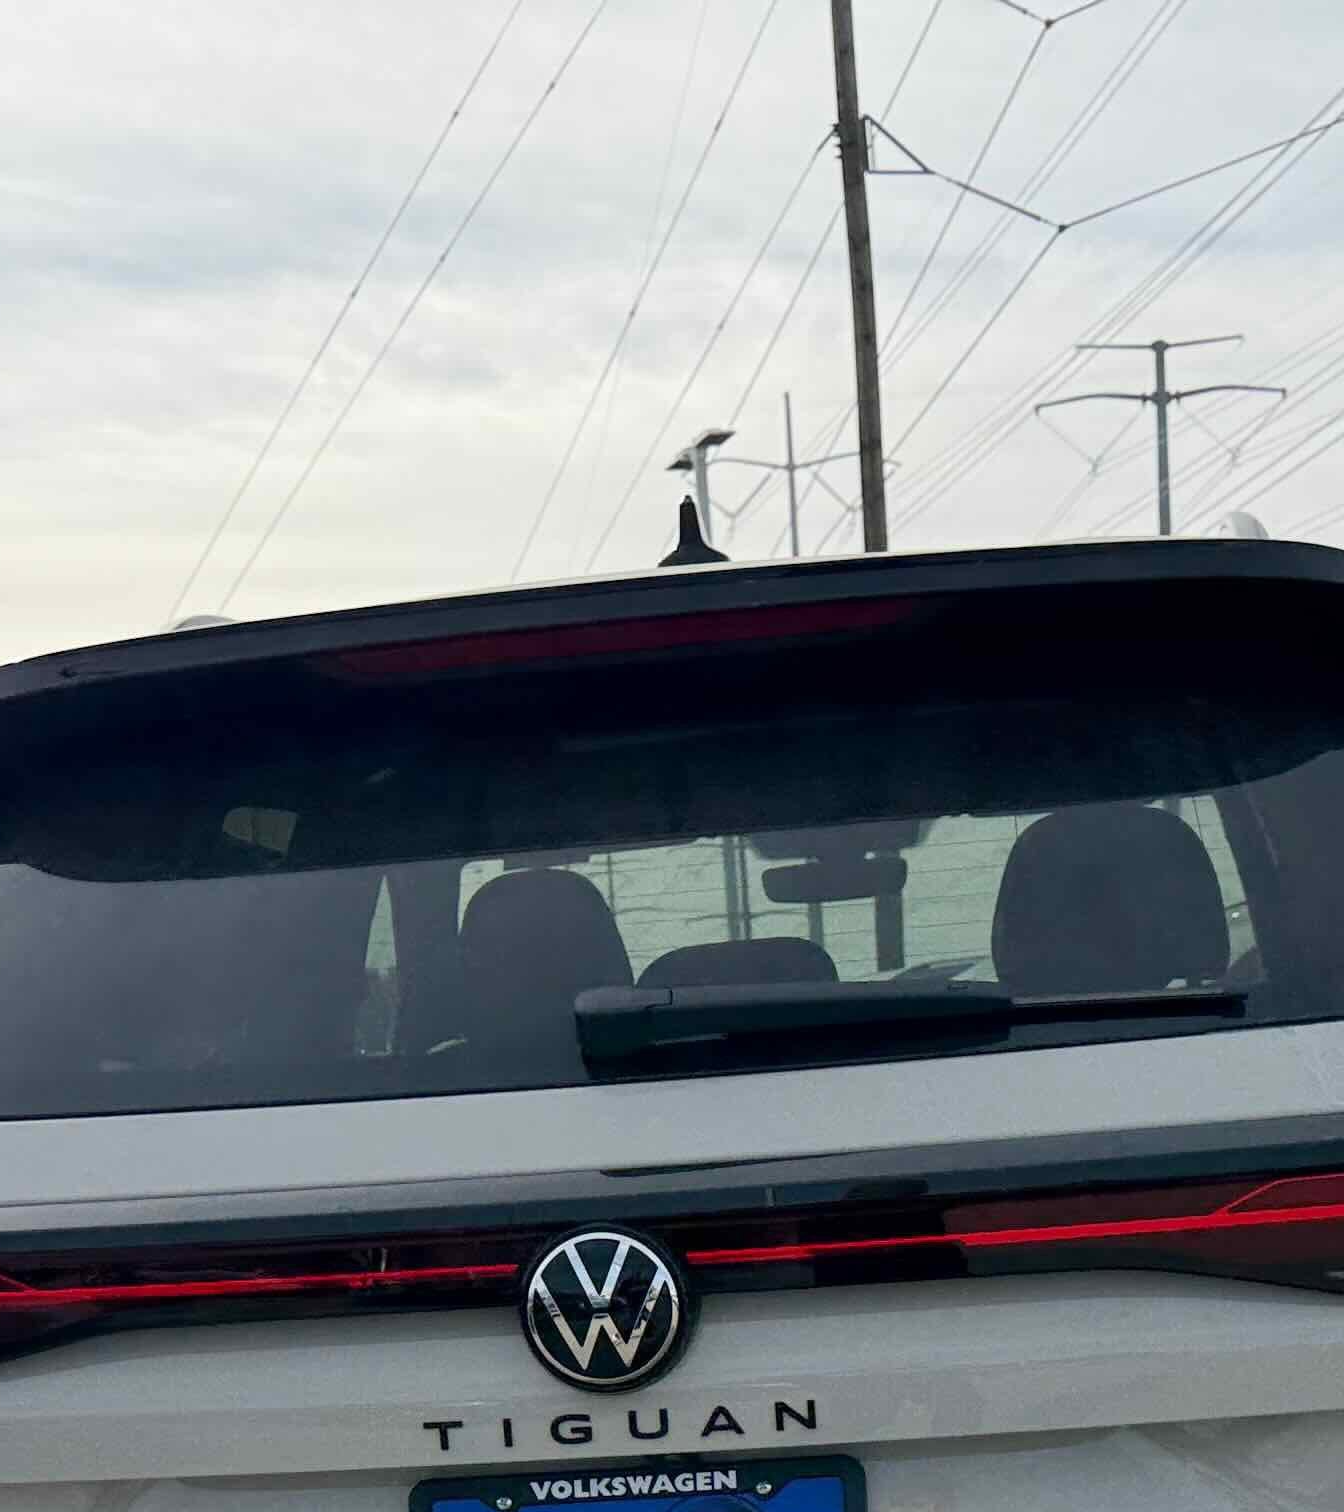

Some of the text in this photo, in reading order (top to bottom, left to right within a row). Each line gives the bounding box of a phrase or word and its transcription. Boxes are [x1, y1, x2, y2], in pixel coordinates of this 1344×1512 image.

[528, 1233, 678, 1382] VW
[423, 1400, 817, 1450] TIGUAN
[530, 1470, 737, 1500] VOLKSWAGEN
